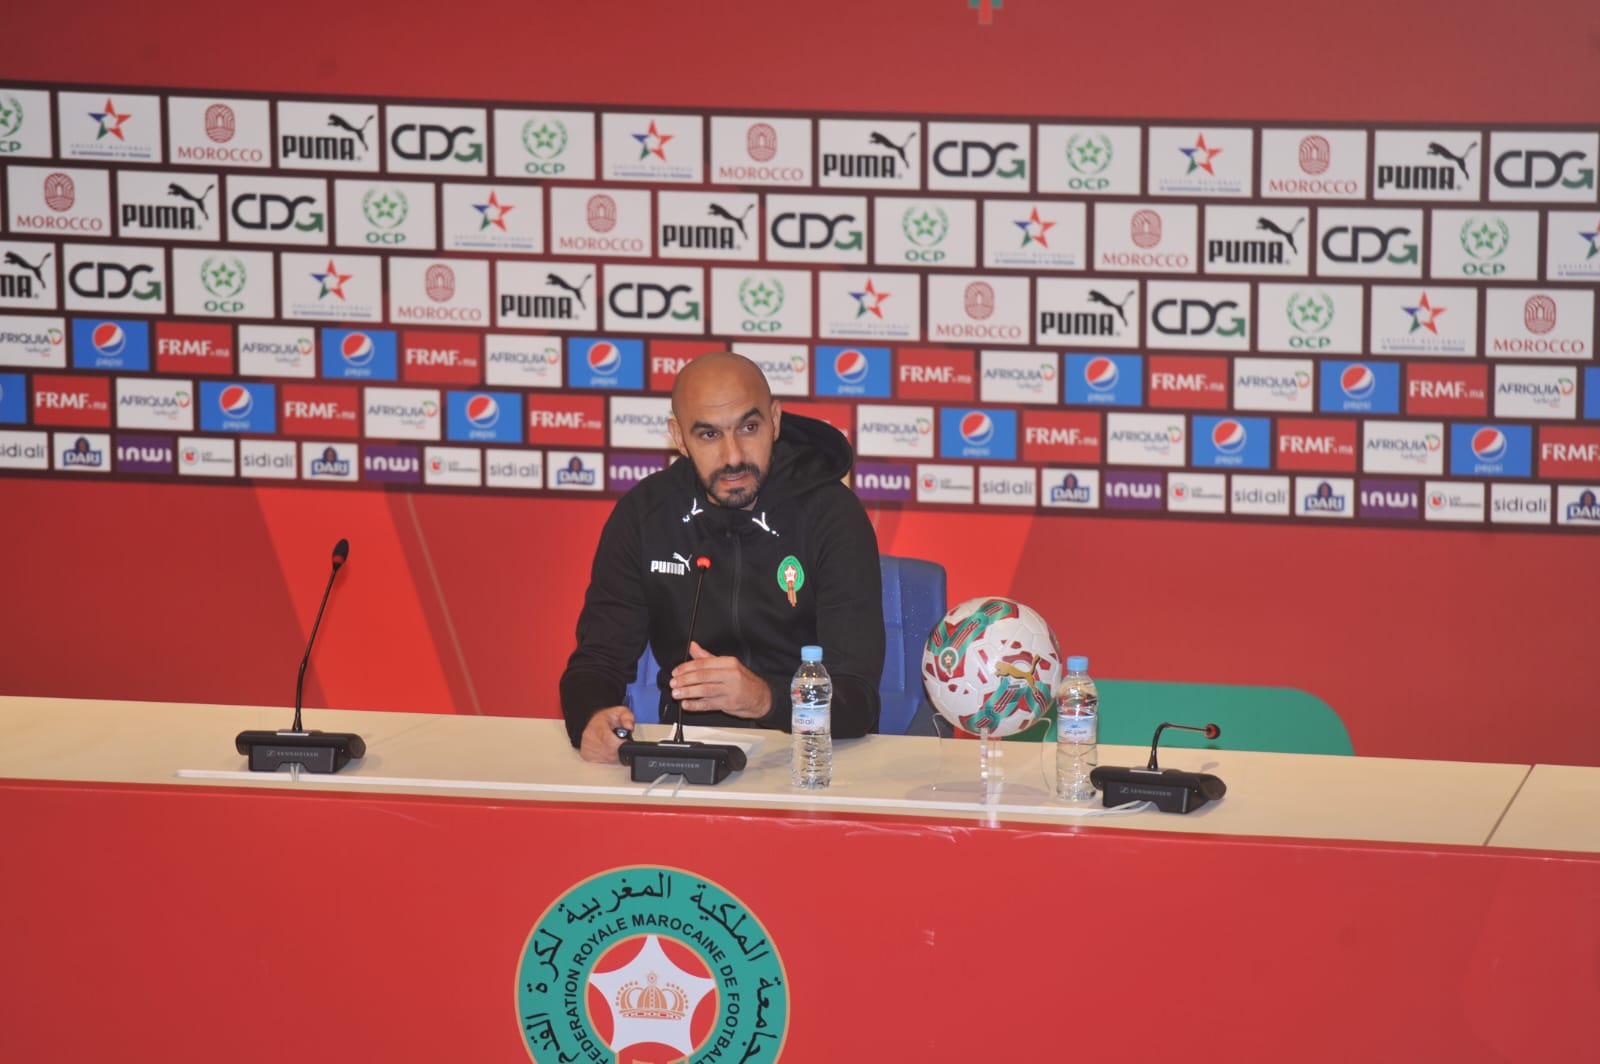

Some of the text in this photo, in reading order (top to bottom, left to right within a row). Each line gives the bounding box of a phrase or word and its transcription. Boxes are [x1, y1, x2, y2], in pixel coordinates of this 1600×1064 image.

[0, 141, 21, 152] CP
[283, 136, 354, 160] PUMA
[391, 124, 482, 162] CDG
[177, 147, 262, 161] MOROCCO
[933, 141, 1025, 179] CDG
[525, 162, 565, 174] OCP
[720, 166, 803, 180] MOROCCO
[823, 154, 896, 178] PUMA
[1494, 151, 1593, 189] CDG
[1069, 177, 1109, 190] OCP
[1378, 165, 1454, 190] PUMA
[1270, 180, 1357, 194] MOROCCO
[122, 204, 195, 230] PUMA
[232, 193, 323, 232] CDG
[17, 215, 102, 231] MOROCCO
[366, 232, 406, 244] OCP
[663, 225, 734, 250] PUMA
[771, 213, 862, 250] CDG
[560, 237, 643, 252] MOROCCO
[1209, 240, 1283, 264] PUMA
[1322, 226, 1418, 264] CDG
[905, 250, 945, 262] OCP
[1102, 253, 1188, 267] MOROCCO
[1463, 263, 1505, 275] OCP
[0, 274, 32, 298] MA
[69, 262, 161, 299] CDG
[204, 301, 244, 312] OCP
[501, 294, 572, 319] PUMA
[609, 283, 699, 320] CDG
[399, 306, 481, 320] MOROCCO
[1152, 300, 1245, 336] CDG
[742, 320, 781, 332] OCP
[936, 324, 1021, 338] MOROCCO
[1041, 312, 1114, 336] PUMA
[0, 332, 50, 344] FRIQUIA
[1289, 336, 1331, 348] OCP
[1494, 339, 1584, 353] MOROCCO
[24, 443, 44, 458] ali
[66, 451, 100, 464] DARI
[244, 454, 270, 468] sidi
[273, 454, 293, 468] ali
[314, 461, 348, 473] DARI
[490, 463, 517, 477] sidi
[519, 463, 538, 478] ali
[560, 471, 593, 483] DARI
[610, 466, 663, 480] inw
[982, 480, 1009, 495] sidi
[1012, 480, 1032, 495] ali
[1055, 489, 1088, 501] DARI
[1235, 489, 1262, 504] sidi
[1265, 489, 1285, 504] ali
[1309, 499, 1342, 510] DARI
[1494, 497, 1523, 513] sidi
[1526, 497, 1546, 513] ali
[1571, 505, 1600, 517] DAR
[651, 560, 684, 576] PUMA
[558, 872, 672, 924] المغربية
[690, 884, 769, 962] الملكية
[572, 917, 628, 967] ROYALE
[632, 913, 726, 964] MAROCAINE
[720, 964, 738, 988] DE
[527, 928, 563, 992] لكرة
